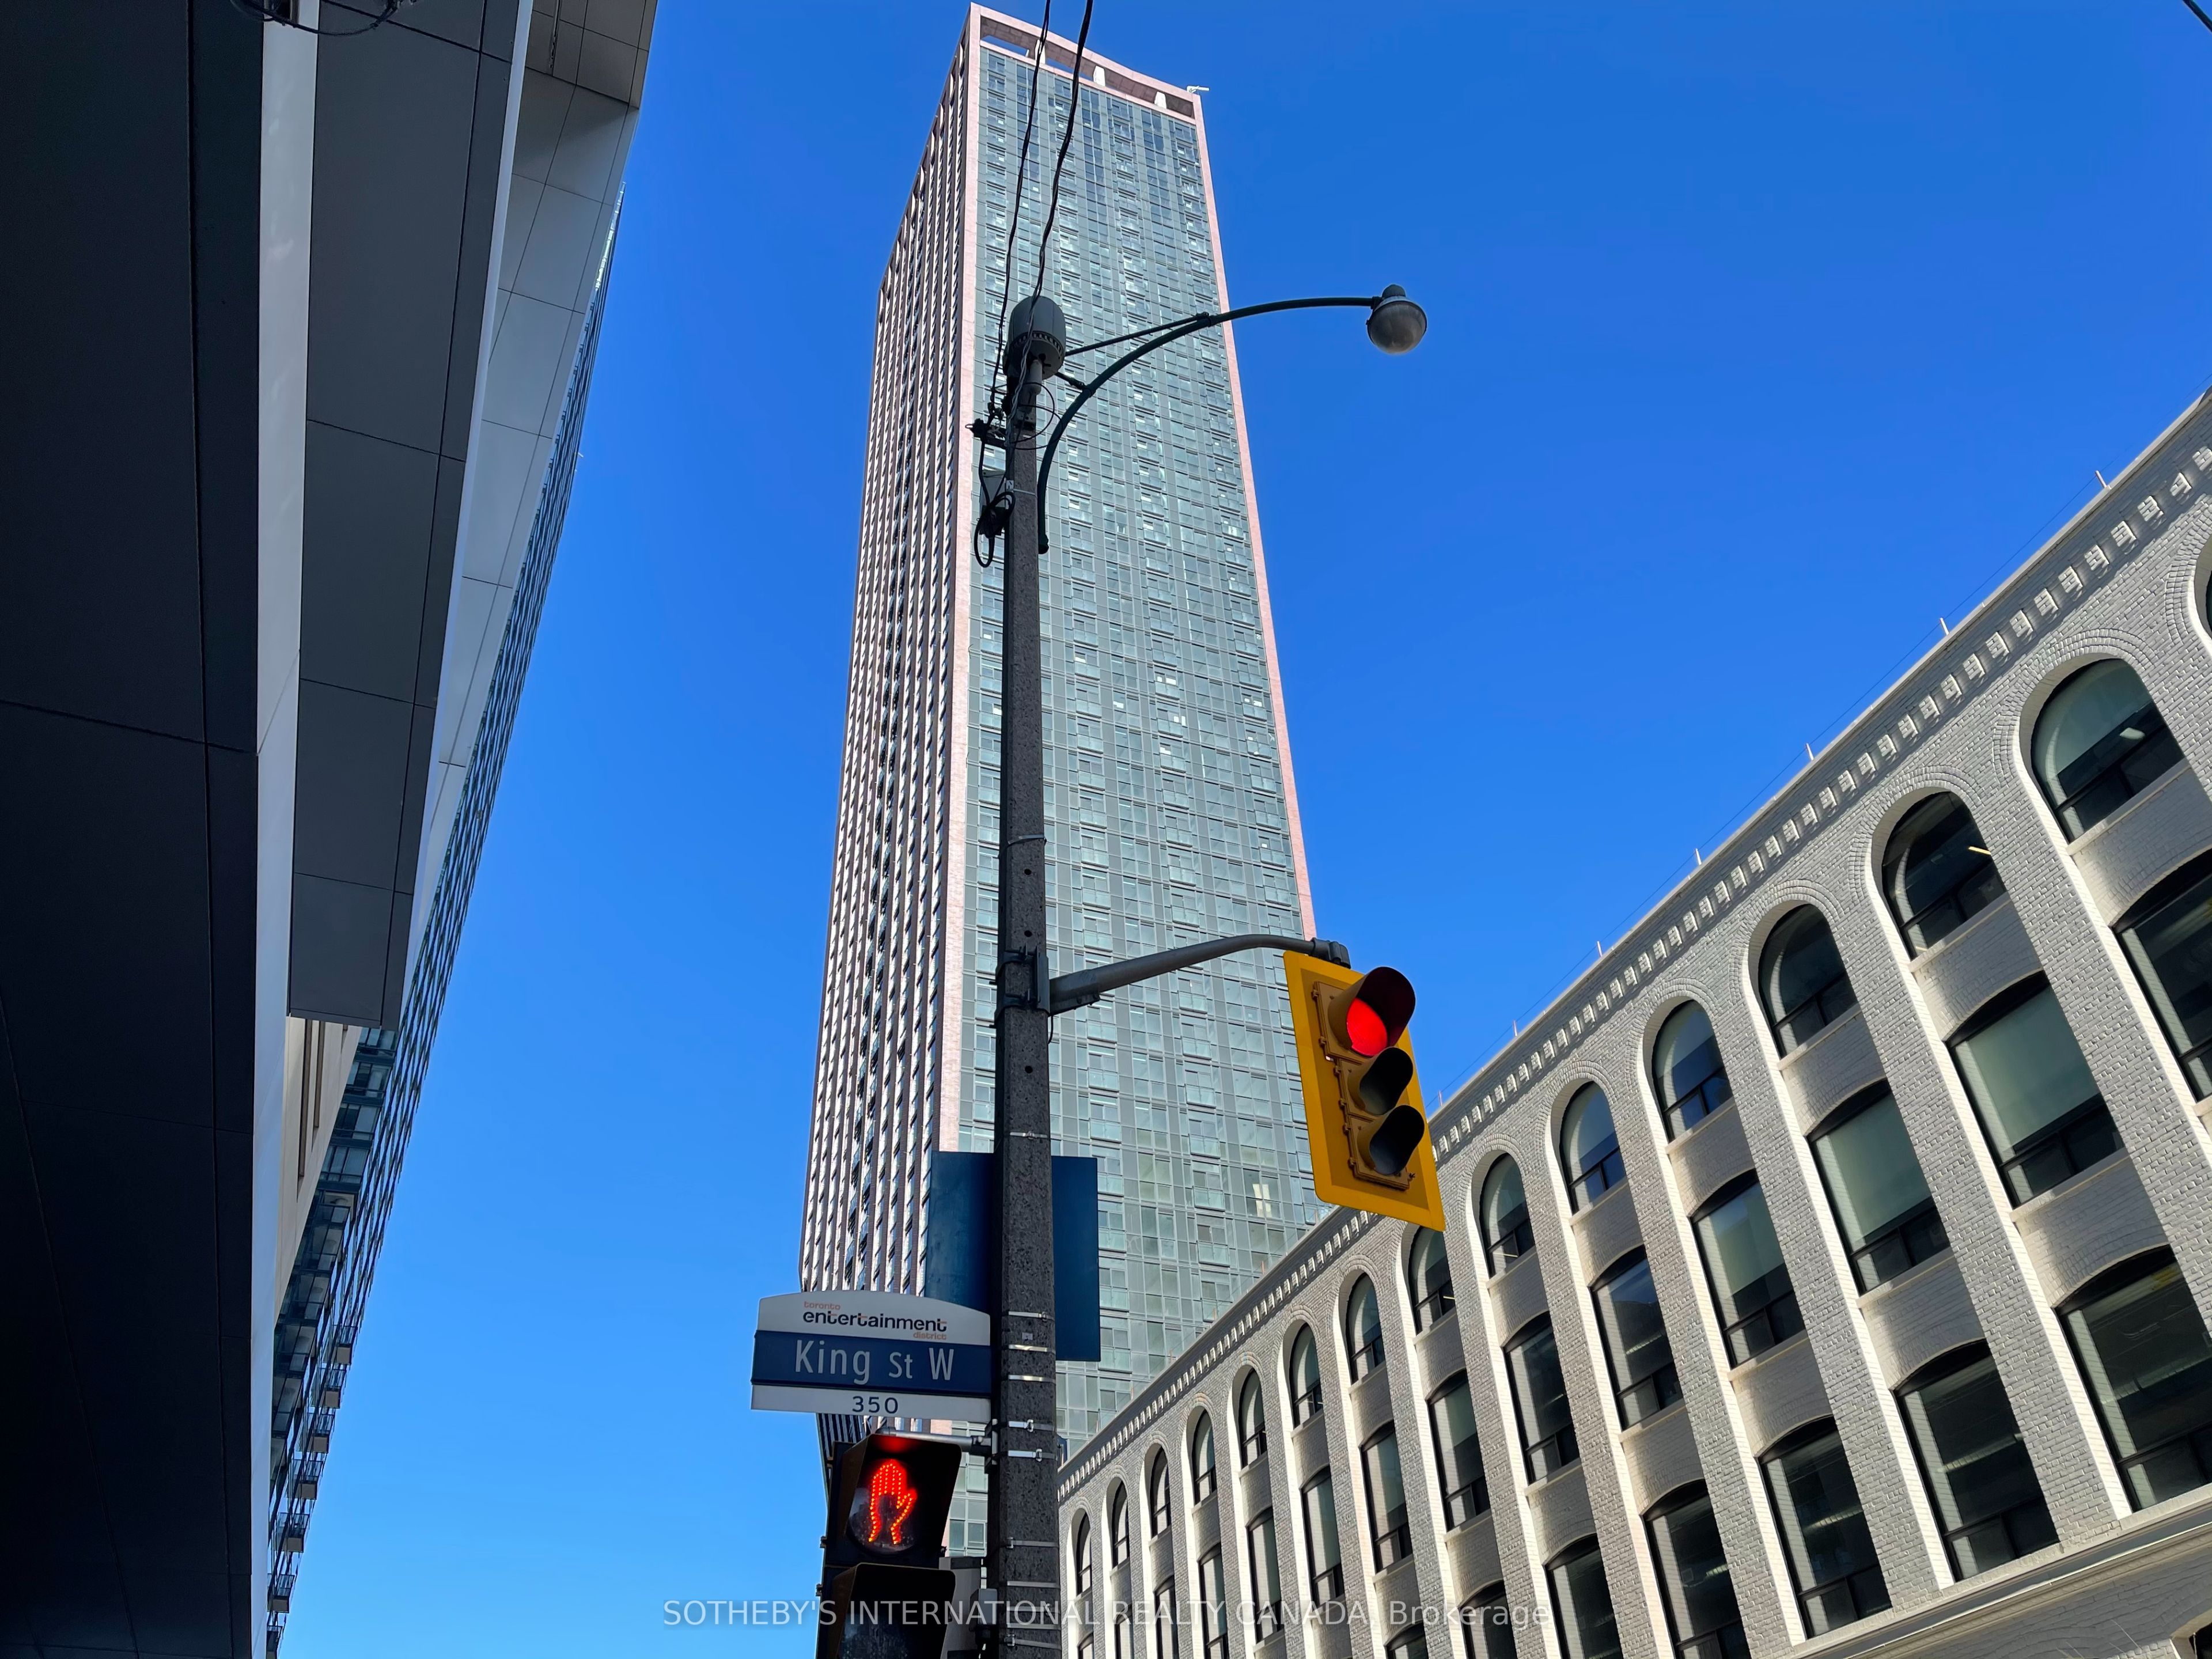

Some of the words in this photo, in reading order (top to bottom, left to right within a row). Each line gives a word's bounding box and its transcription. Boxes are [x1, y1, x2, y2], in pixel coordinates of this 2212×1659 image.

[804, 1301, 840, 1310] toronto
[803, 1310, 947, 1332] entertainment
[913, 1332, 947, 1340] district
[795, 1339, 870, 1385] King
[888, 1351, 913, 1379] St
[929, 1347, 954, 1381] W
[852, 1395, 899, 1414] 350
